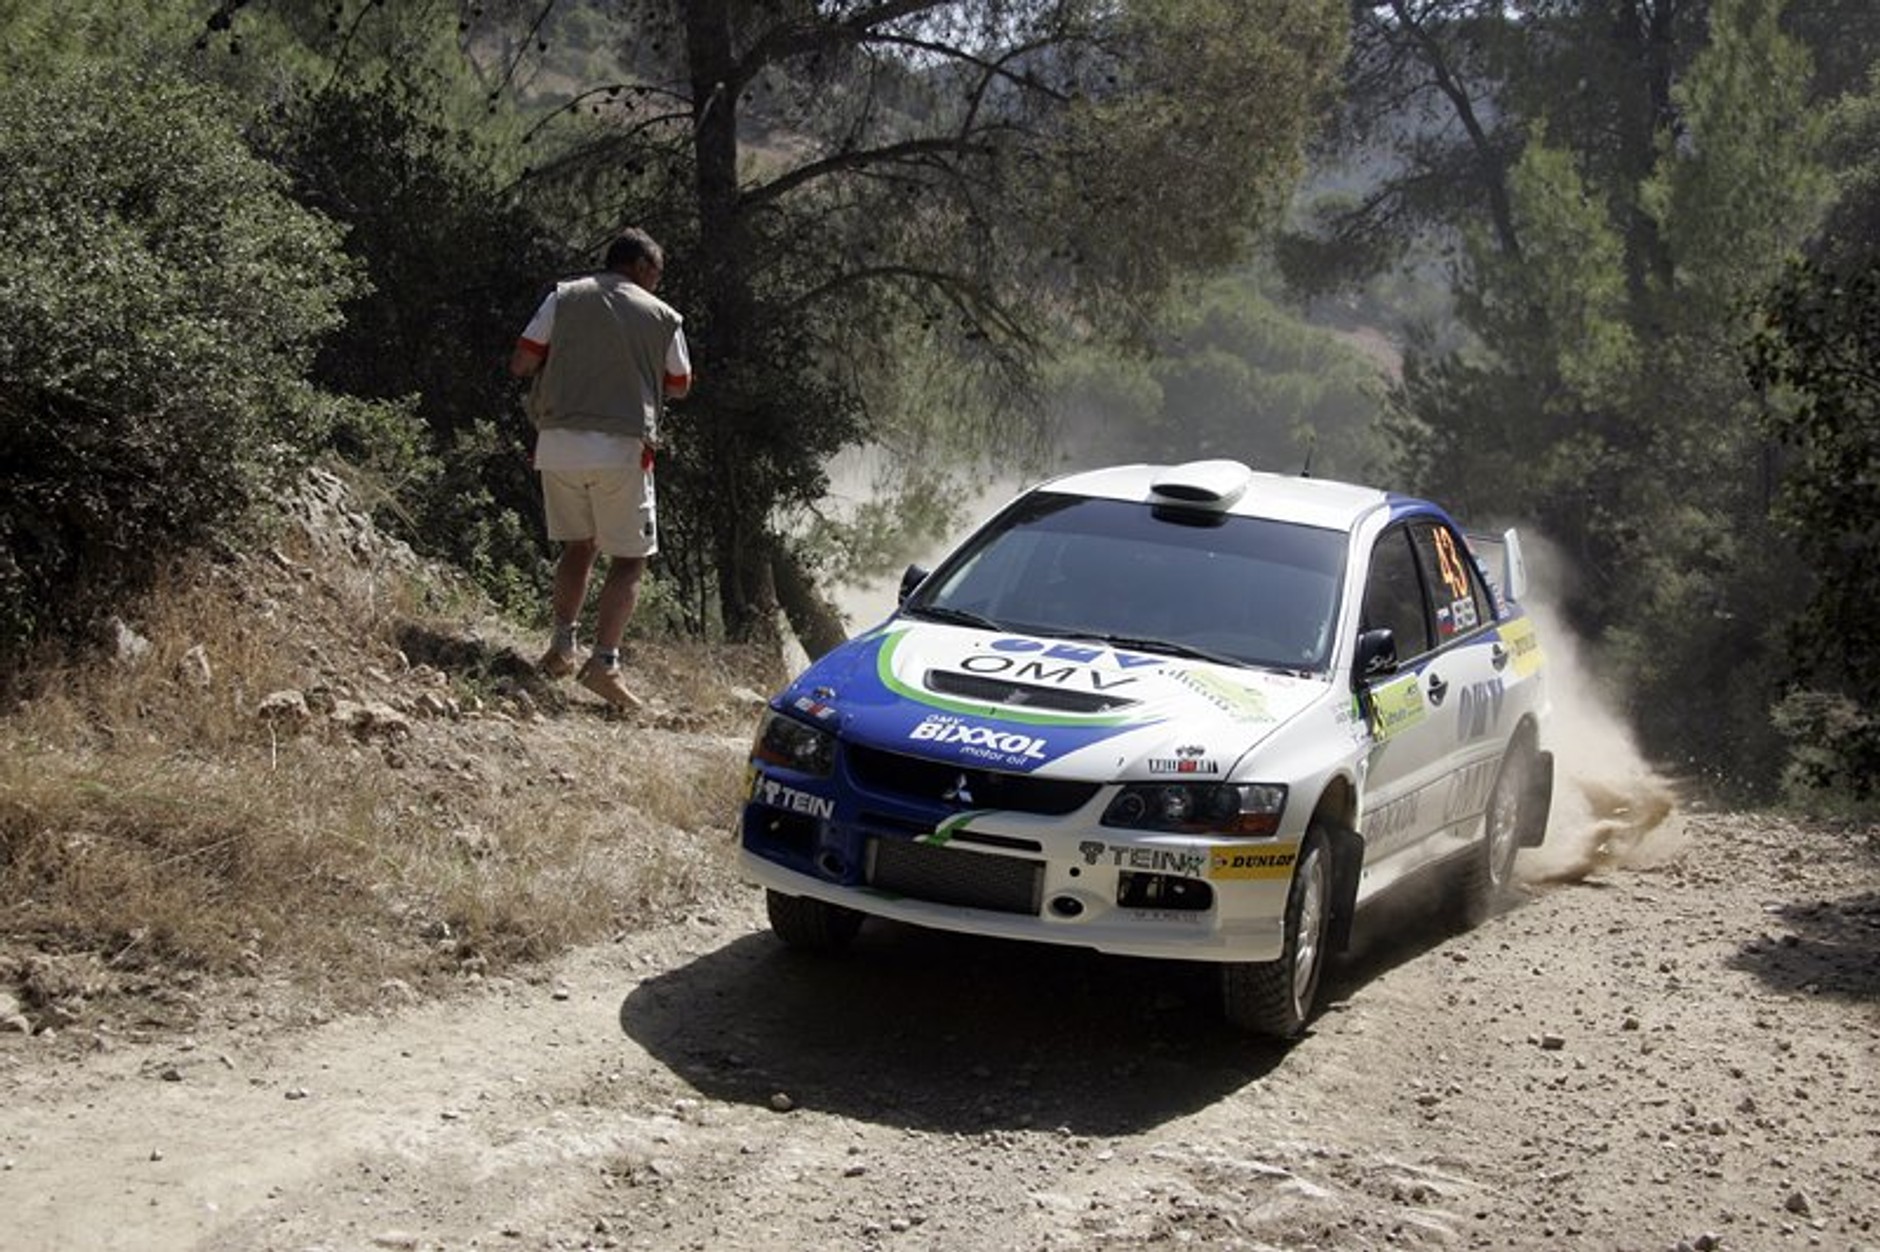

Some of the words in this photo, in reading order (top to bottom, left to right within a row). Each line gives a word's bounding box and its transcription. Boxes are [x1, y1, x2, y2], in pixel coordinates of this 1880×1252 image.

[1433, 526, 1468, 598] 43
[960, 655, 1138, 690] OMV
[960, 746, 1005, 761] motor
[1006, 754, 1028, 766] oil
[782, 786, 835, 819] TEIN
[1109, 845, 1192, 872] TEIN
[1231, 853, 1296, 869] DUNLOP
